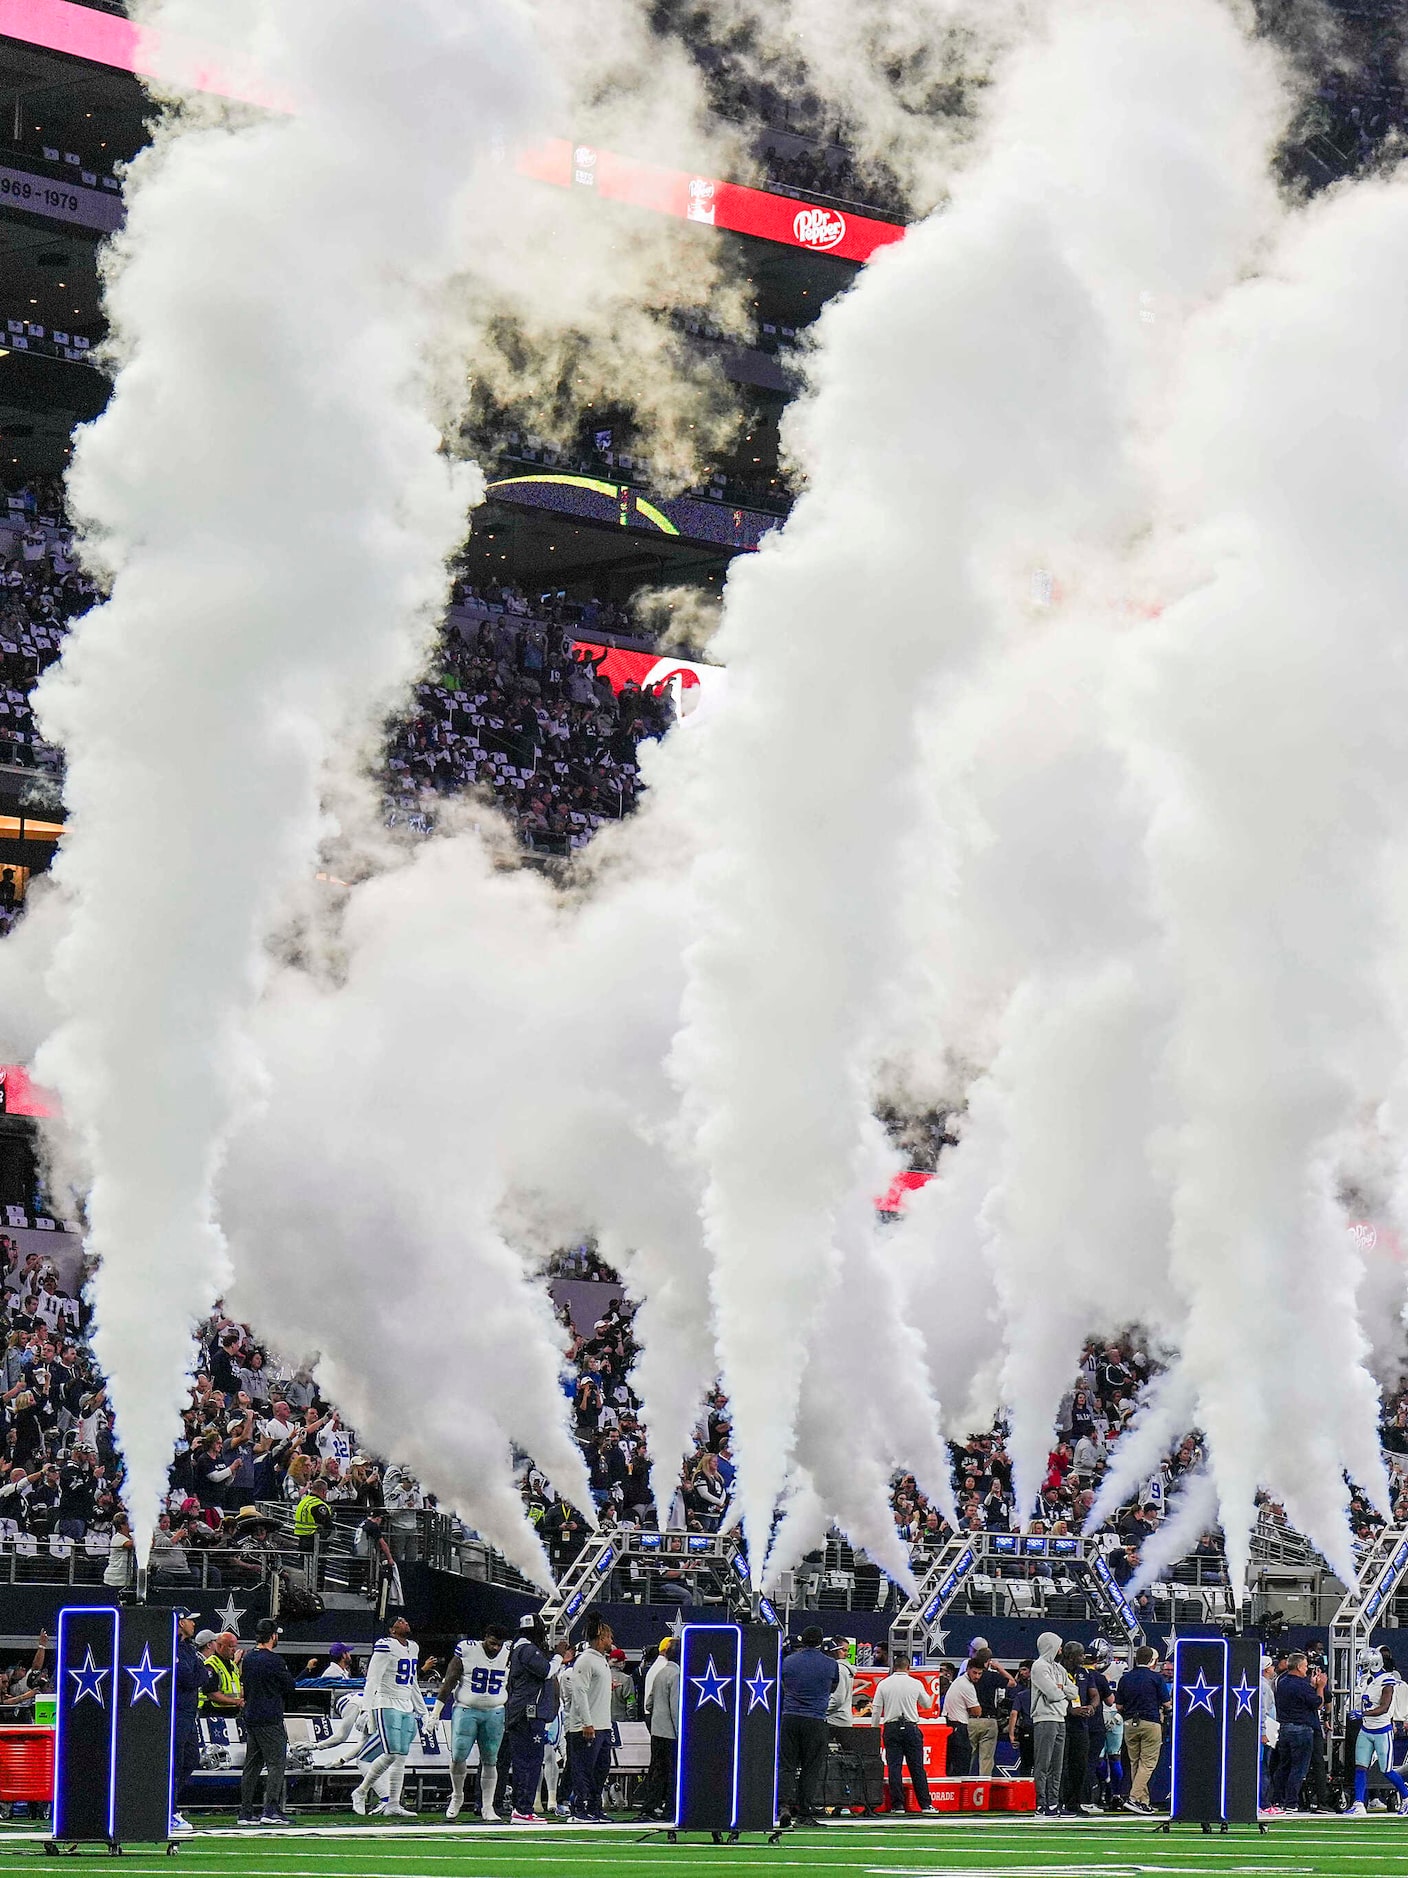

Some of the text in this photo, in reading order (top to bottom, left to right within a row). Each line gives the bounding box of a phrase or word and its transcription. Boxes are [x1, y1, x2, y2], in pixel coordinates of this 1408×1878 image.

[811, 209, 830, 226] Dr
[795, 211, 842, 244] Pepper
[549, 669, 561, 683] 19
[45, 1296, 57, 1315] 11
[1152, 1482, 1161, 1499] 9
[471, 1667, 506, 1695] 95
[973, 1787, 984, 1807] G
